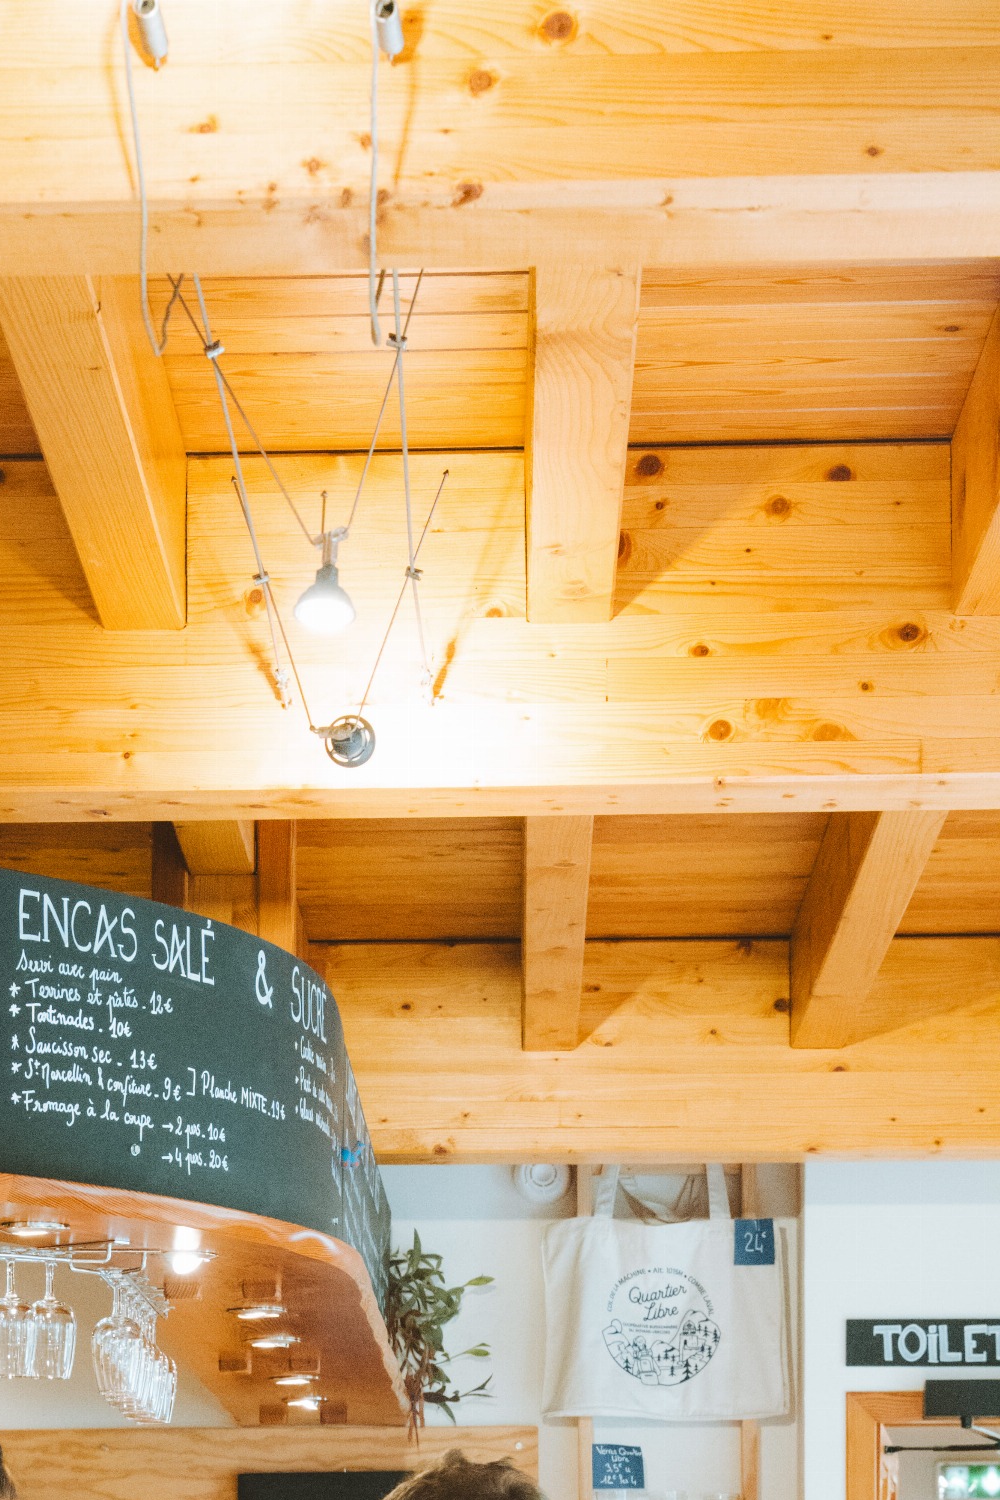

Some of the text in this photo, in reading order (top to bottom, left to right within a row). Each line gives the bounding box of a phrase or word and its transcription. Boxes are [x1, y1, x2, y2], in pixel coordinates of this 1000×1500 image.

[19, 888, 138, 962] ENCAS
[151, 919, 215, 986] SALÉ
[255, 950, 274, 1009] &
[16, 949, 122, 989] Servi avec pain
[25, 978, 81, 1001] Terrines
[87, 988, 102, 1006] et
[26, 1026, 88, 1059] Saucisson
[201, 1071, 238, 1104] Planche
[22, 1090, 81, 1127] Fromage
[87, 1099, 97, 1117] à
[100, 1099, 119, 1122] la
[628, 1284, 687, 1305] Quartier
[643, 1302, 679, 1321] Libre
